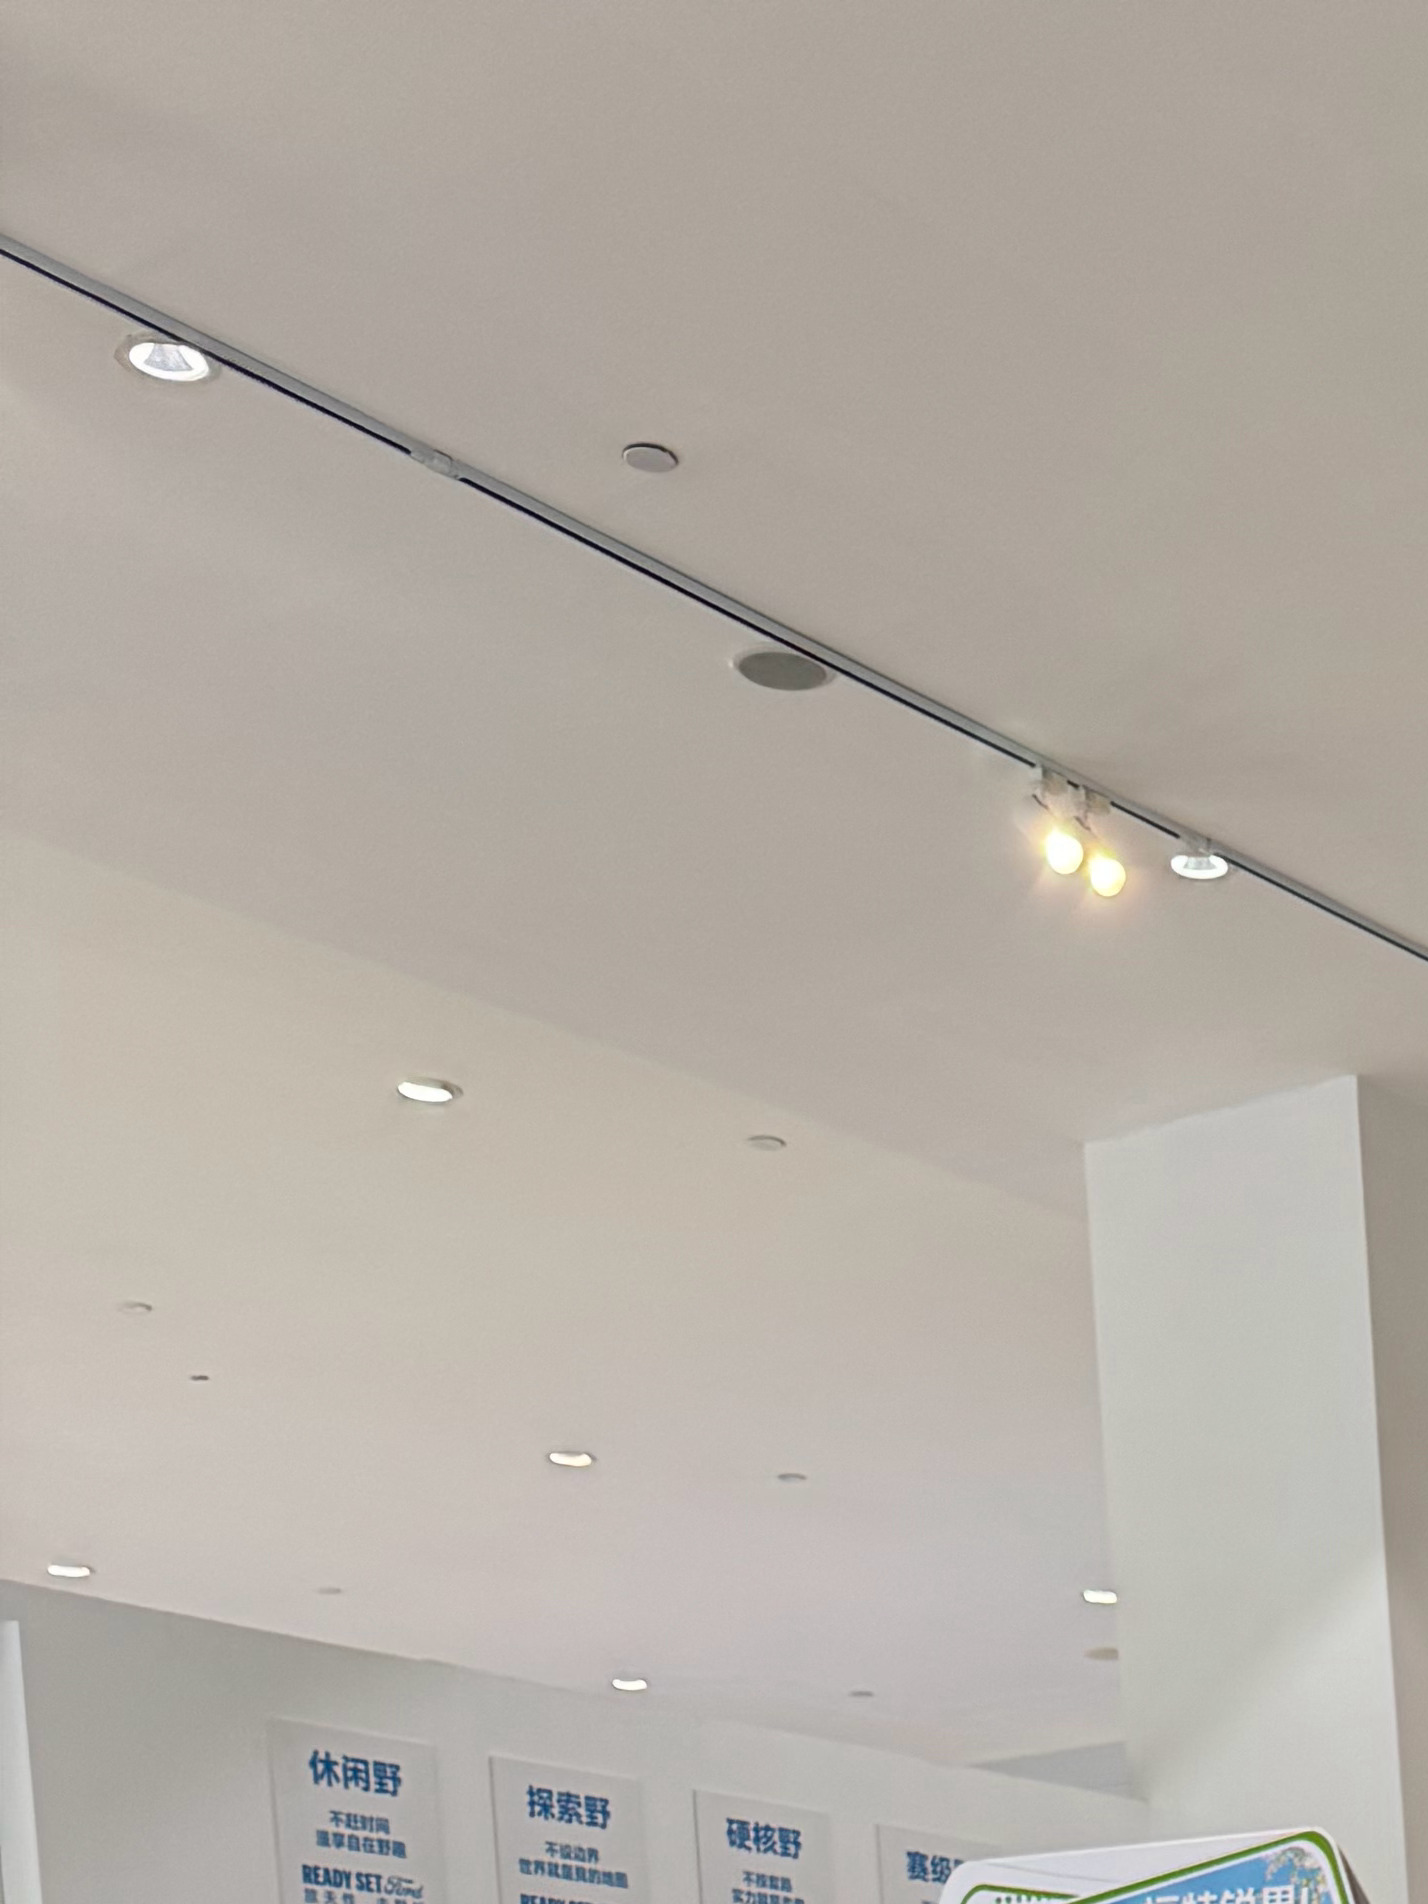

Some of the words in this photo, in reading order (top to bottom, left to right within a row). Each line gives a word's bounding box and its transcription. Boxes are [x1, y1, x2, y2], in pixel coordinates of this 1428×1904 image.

[309, 1749, 402, 1797] 休闲野
[527, 1785, 611, 1830] 探索野
[726, 1818, 802, 1859] 硬核野
[302, 1864, 351, 1890] READY
[356, 1872, 382, 1894] SET
[384, 1875, 424, 1899] Ford
[906, 1850, 964, 1884] 赛级
